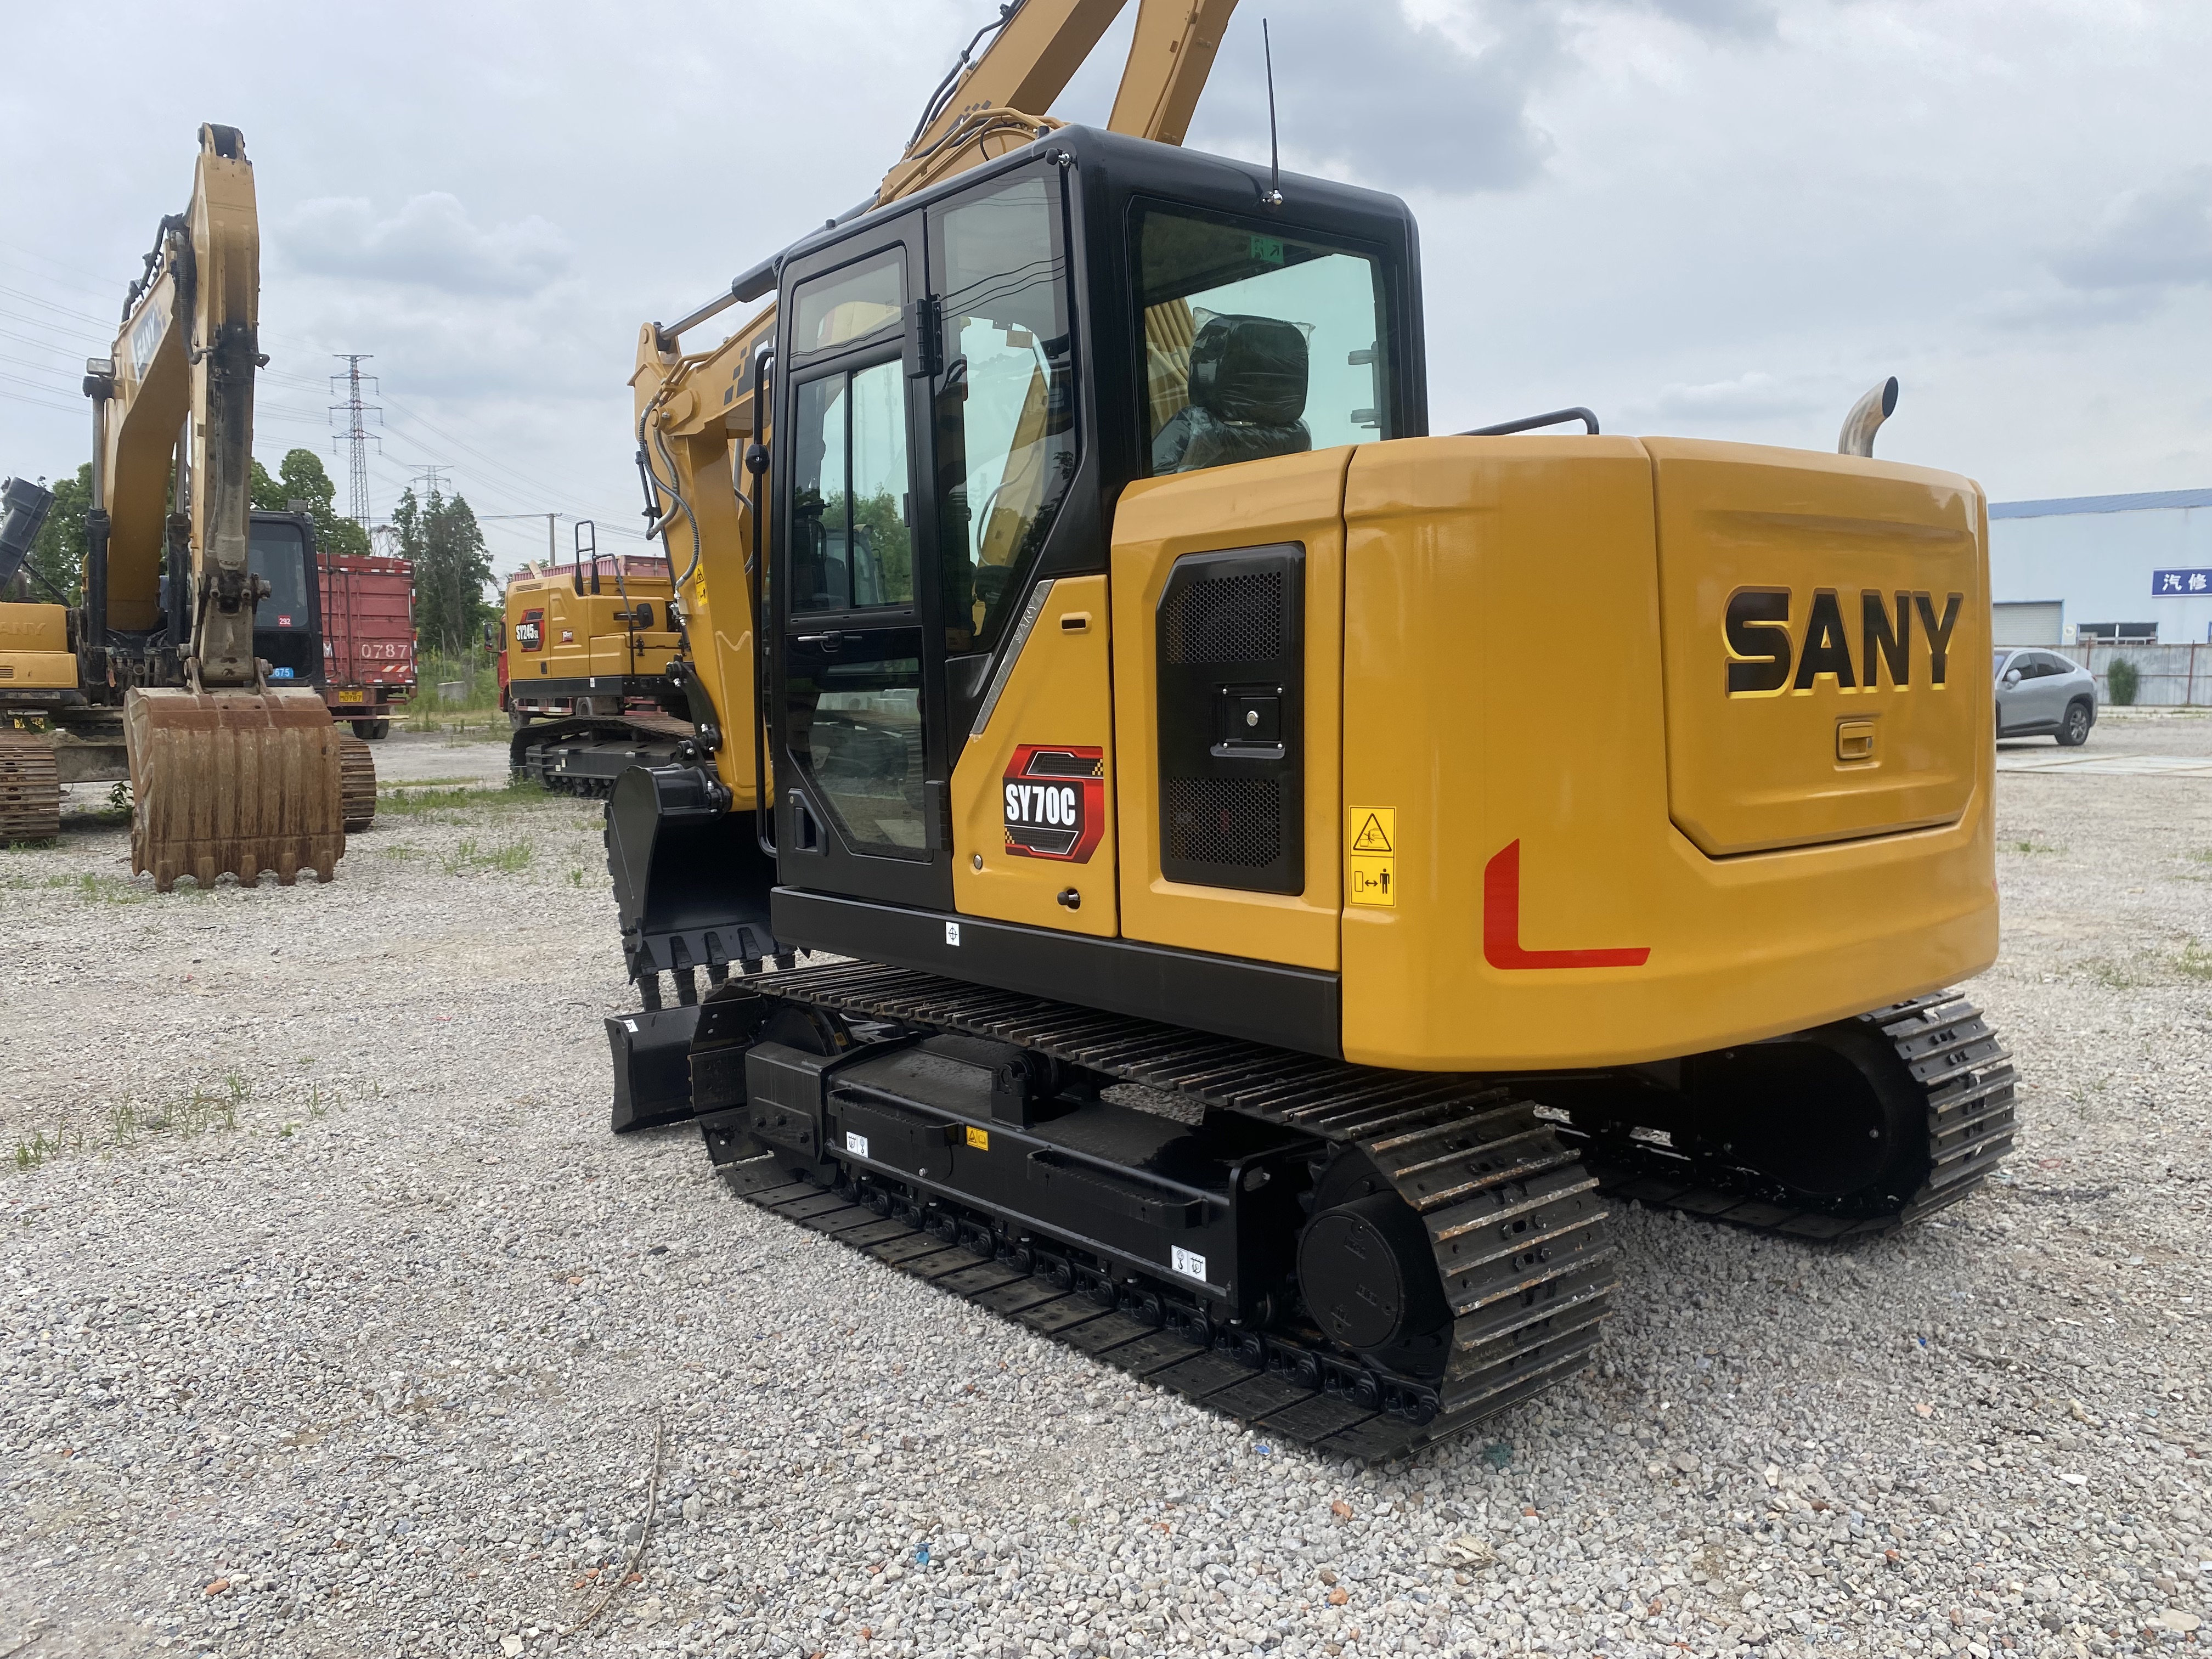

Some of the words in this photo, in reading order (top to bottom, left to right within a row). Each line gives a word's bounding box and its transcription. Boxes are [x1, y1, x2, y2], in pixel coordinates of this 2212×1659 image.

[137, 310, 155, 369] SANY
[2162, 573, 2208, 591] 汽修
[516, 623, 534, 640] SY245
[1722, 586, 1963, 698] SANY
[362, 644, 408, 659] 0787
[272, 668, 290, 676] 675
[1005, 783, 1076, 826] SY70C
